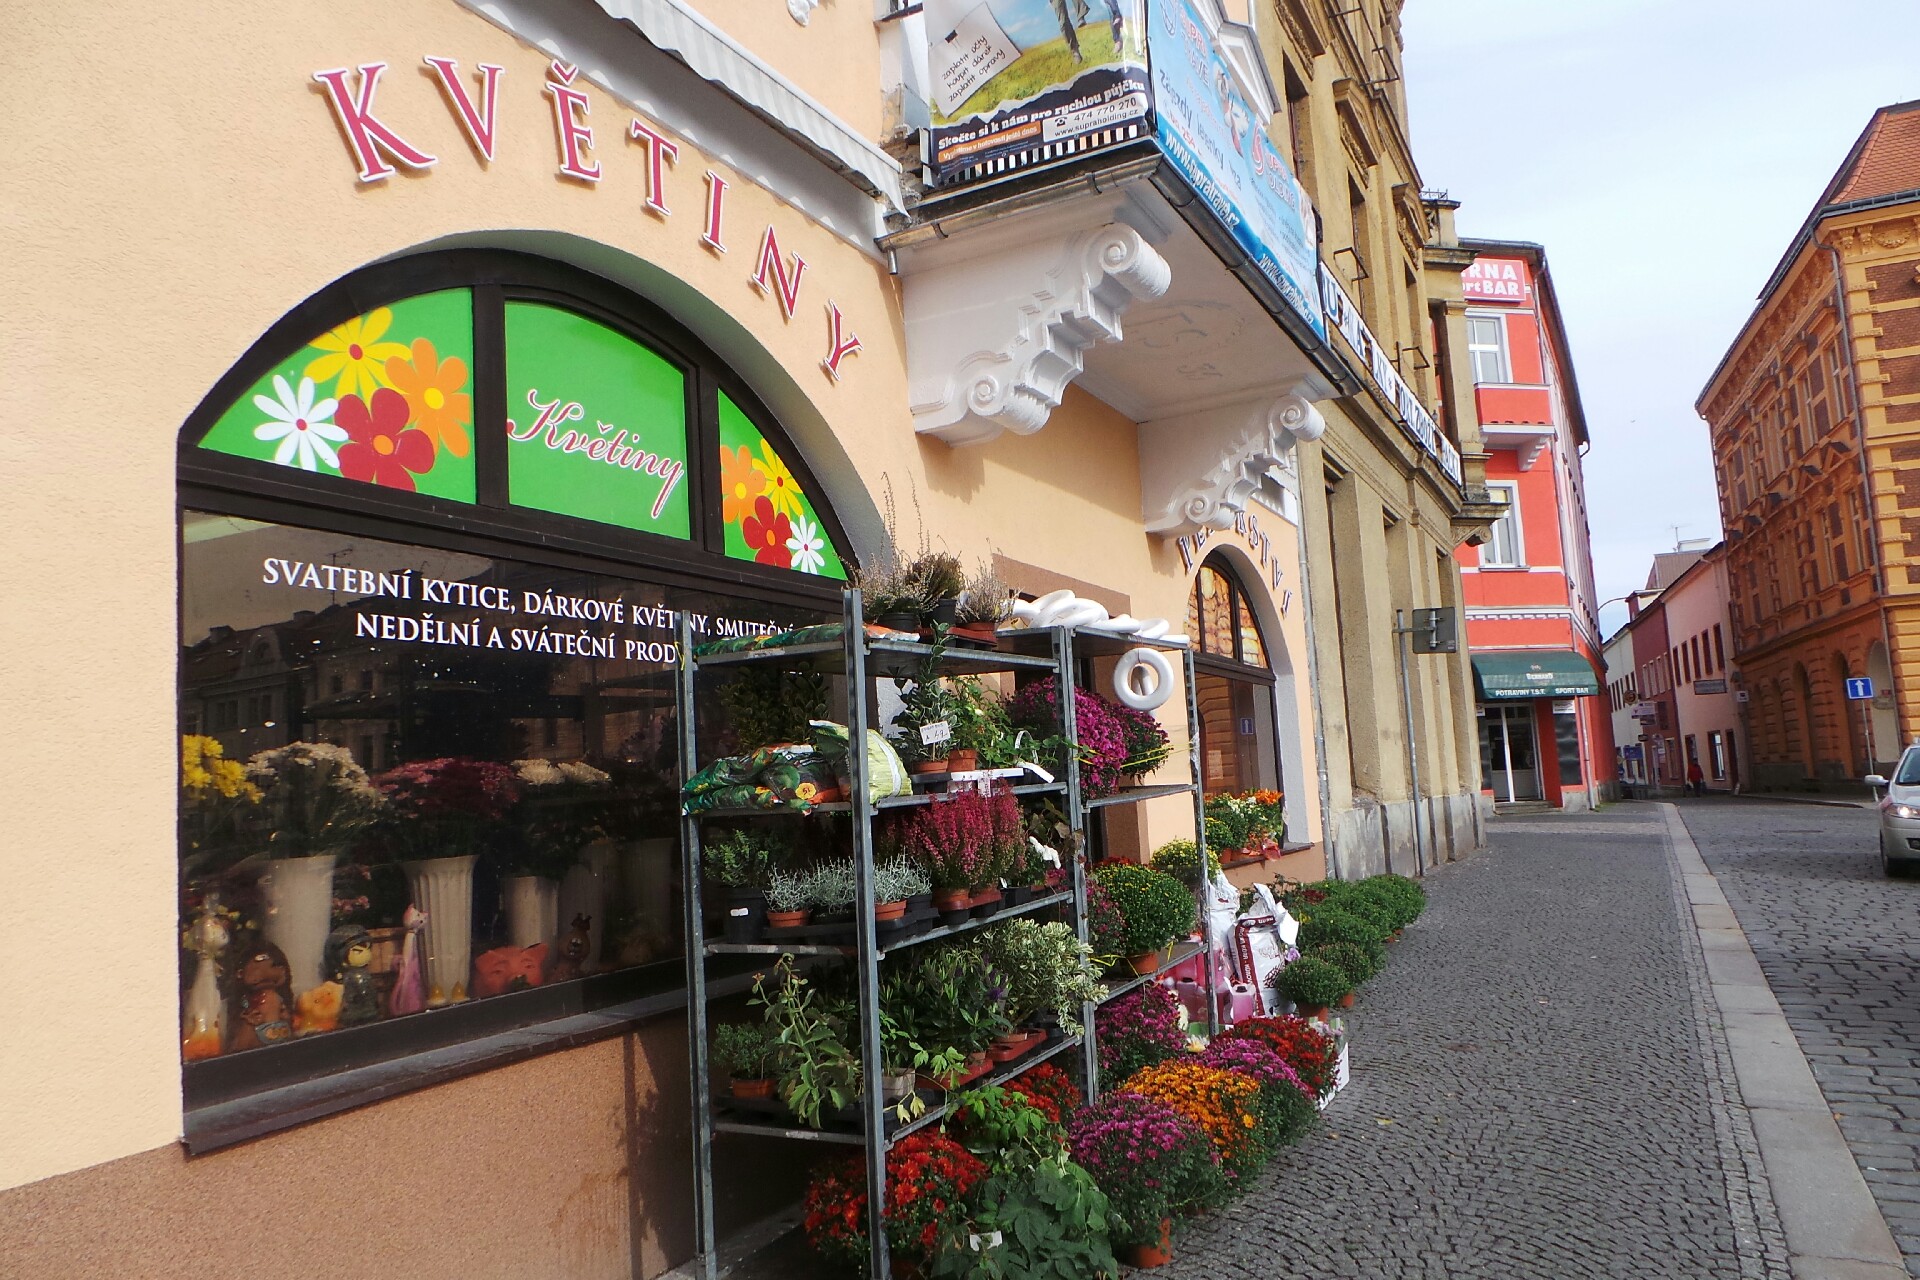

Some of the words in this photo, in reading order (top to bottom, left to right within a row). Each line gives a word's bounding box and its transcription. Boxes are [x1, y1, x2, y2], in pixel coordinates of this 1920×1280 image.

[948, 74, 976, 102] zaplatit
[978, 49, 1006, 75] opravy
[938, 131, 976, 150] Skočte
[978, 123, 989, 137] si
[991, 121, 1000, 133] k
[1001, 113, 1028, 129] nám
[1030, 109, 1052, 123] pro
[1054, 93, 1102, 116] rychlou
[1103, 79, 1145, 102] půjčku
[1074, 110, 1093, 122] 474
[1097, 104, 1115, 116] 770
[1118, 97, 1137, 111] 270
[313, 55, 863, 382] KVĚTINY
[1461, 262, 1517, 280] RNA
[506, 389, 685, 519] Květiny
[262, 557, 412, 600] SVATEBNÍ
[420, 577, 516, 615] KYTICE,
[523, 587, 625, 625] DÁRKOVÉ
[632, 603, 711, 637] KVĚTNY,
[356, 611, 480, 648] NEDĚLNÍ
[486, 625, 504, 651] A
[511, 624, 616, 660] SVÁTEČNÍ
